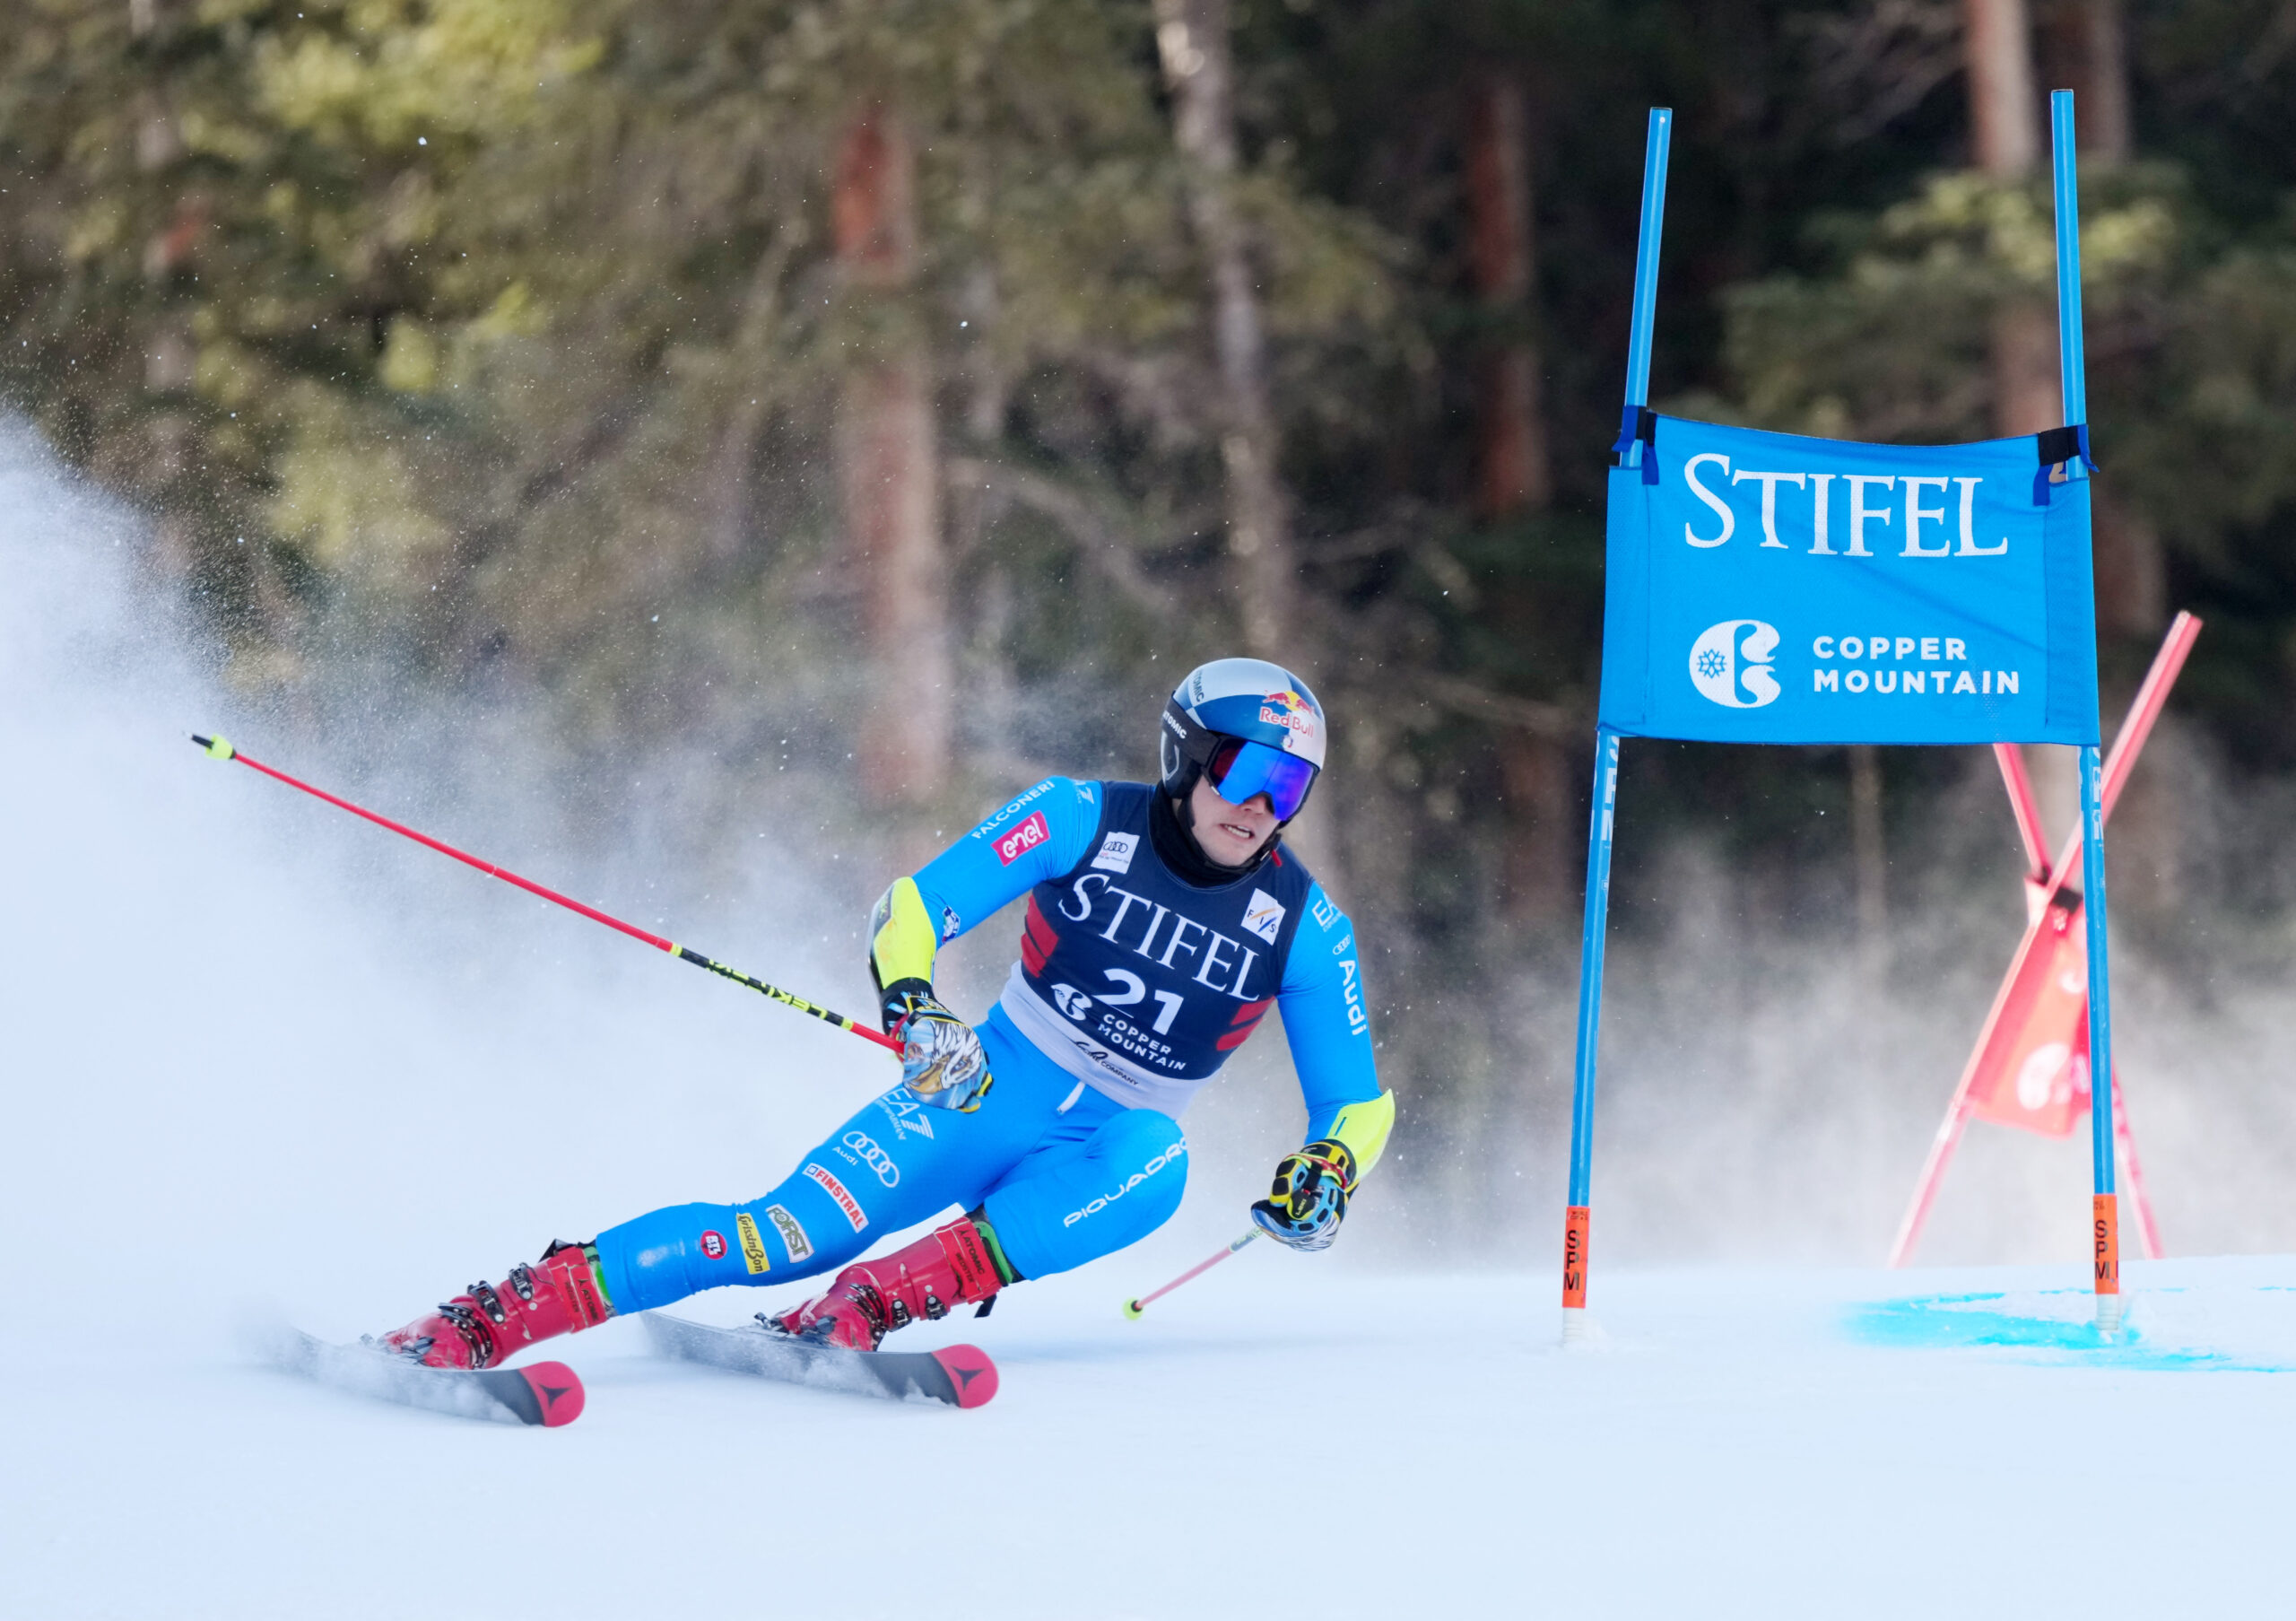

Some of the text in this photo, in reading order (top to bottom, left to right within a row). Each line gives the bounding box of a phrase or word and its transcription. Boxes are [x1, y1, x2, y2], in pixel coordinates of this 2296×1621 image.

[1683, 452, 2008, 558] STIFEL
[1812, 635, 1968, 661] COPPER
[1813, 668, 2020, 695] MOUNTAIN
[1259, 707, 1315, 738] Red Bull
[971, 780, 1056, 839] FALCONERI
[1002, 816, 1044, 858] enel
[1058, 873, 1260, 1003] STIFEL
[1091, 967, 1184, 1036] 21
[1338, 959, 1367, 1036] Audi
[1097, 1023, 1187, 1071] MOUNTAIN
[1102, 1013, 1172, 1055] COPPER
[1100, 1060, 1139, 1086] COMPANY
[882, 1086, 935, 1140] EA7
[831, 1146, 859, 1166] Audi
[814, 1169, 865, 1229] FINSTRAL
[768, 1207, 810, 1257] FORST
[963, 1236, 986, 1275] ATOMIC
